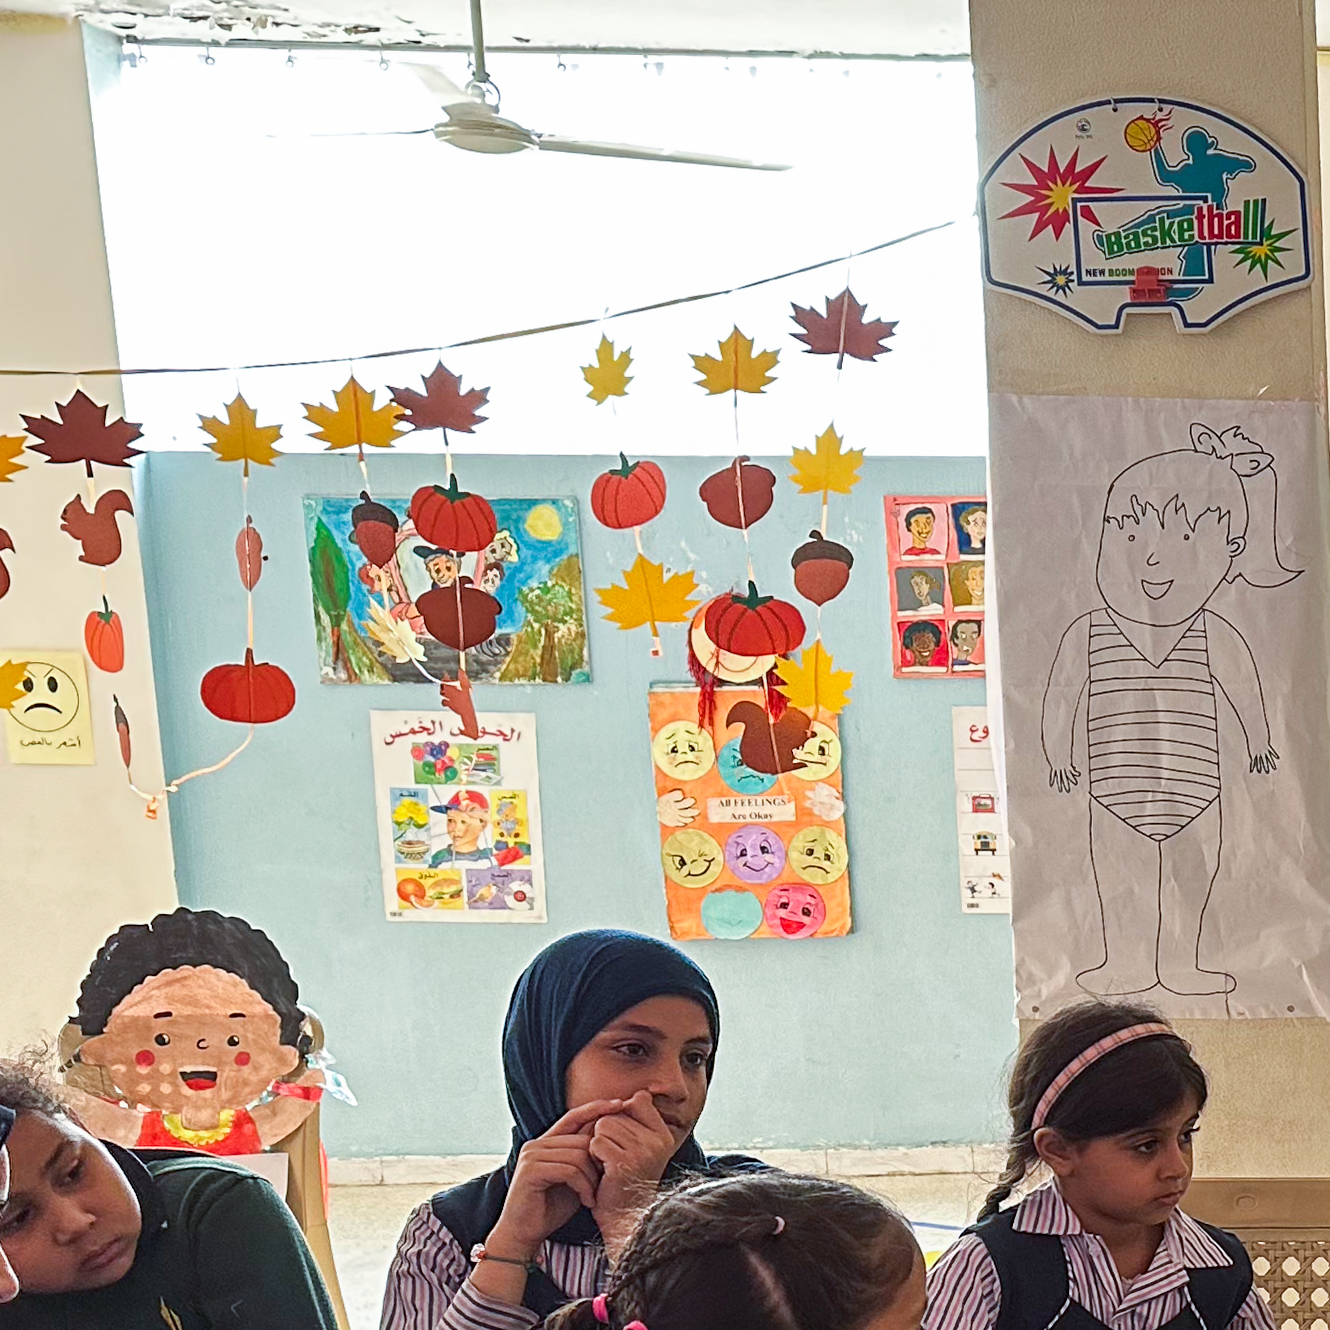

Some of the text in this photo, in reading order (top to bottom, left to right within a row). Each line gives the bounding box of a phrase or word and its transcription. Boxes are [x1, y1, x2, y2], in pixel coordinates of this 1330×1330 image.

[1104, 198, 1266, 259] Basketball
[1085, 268, 1106, 278] NEW
[1108, 267, 1136, 277] BOOM
[734, 798, 787, 807] FEELINGS
[749, 812, 773, 821] Okay
